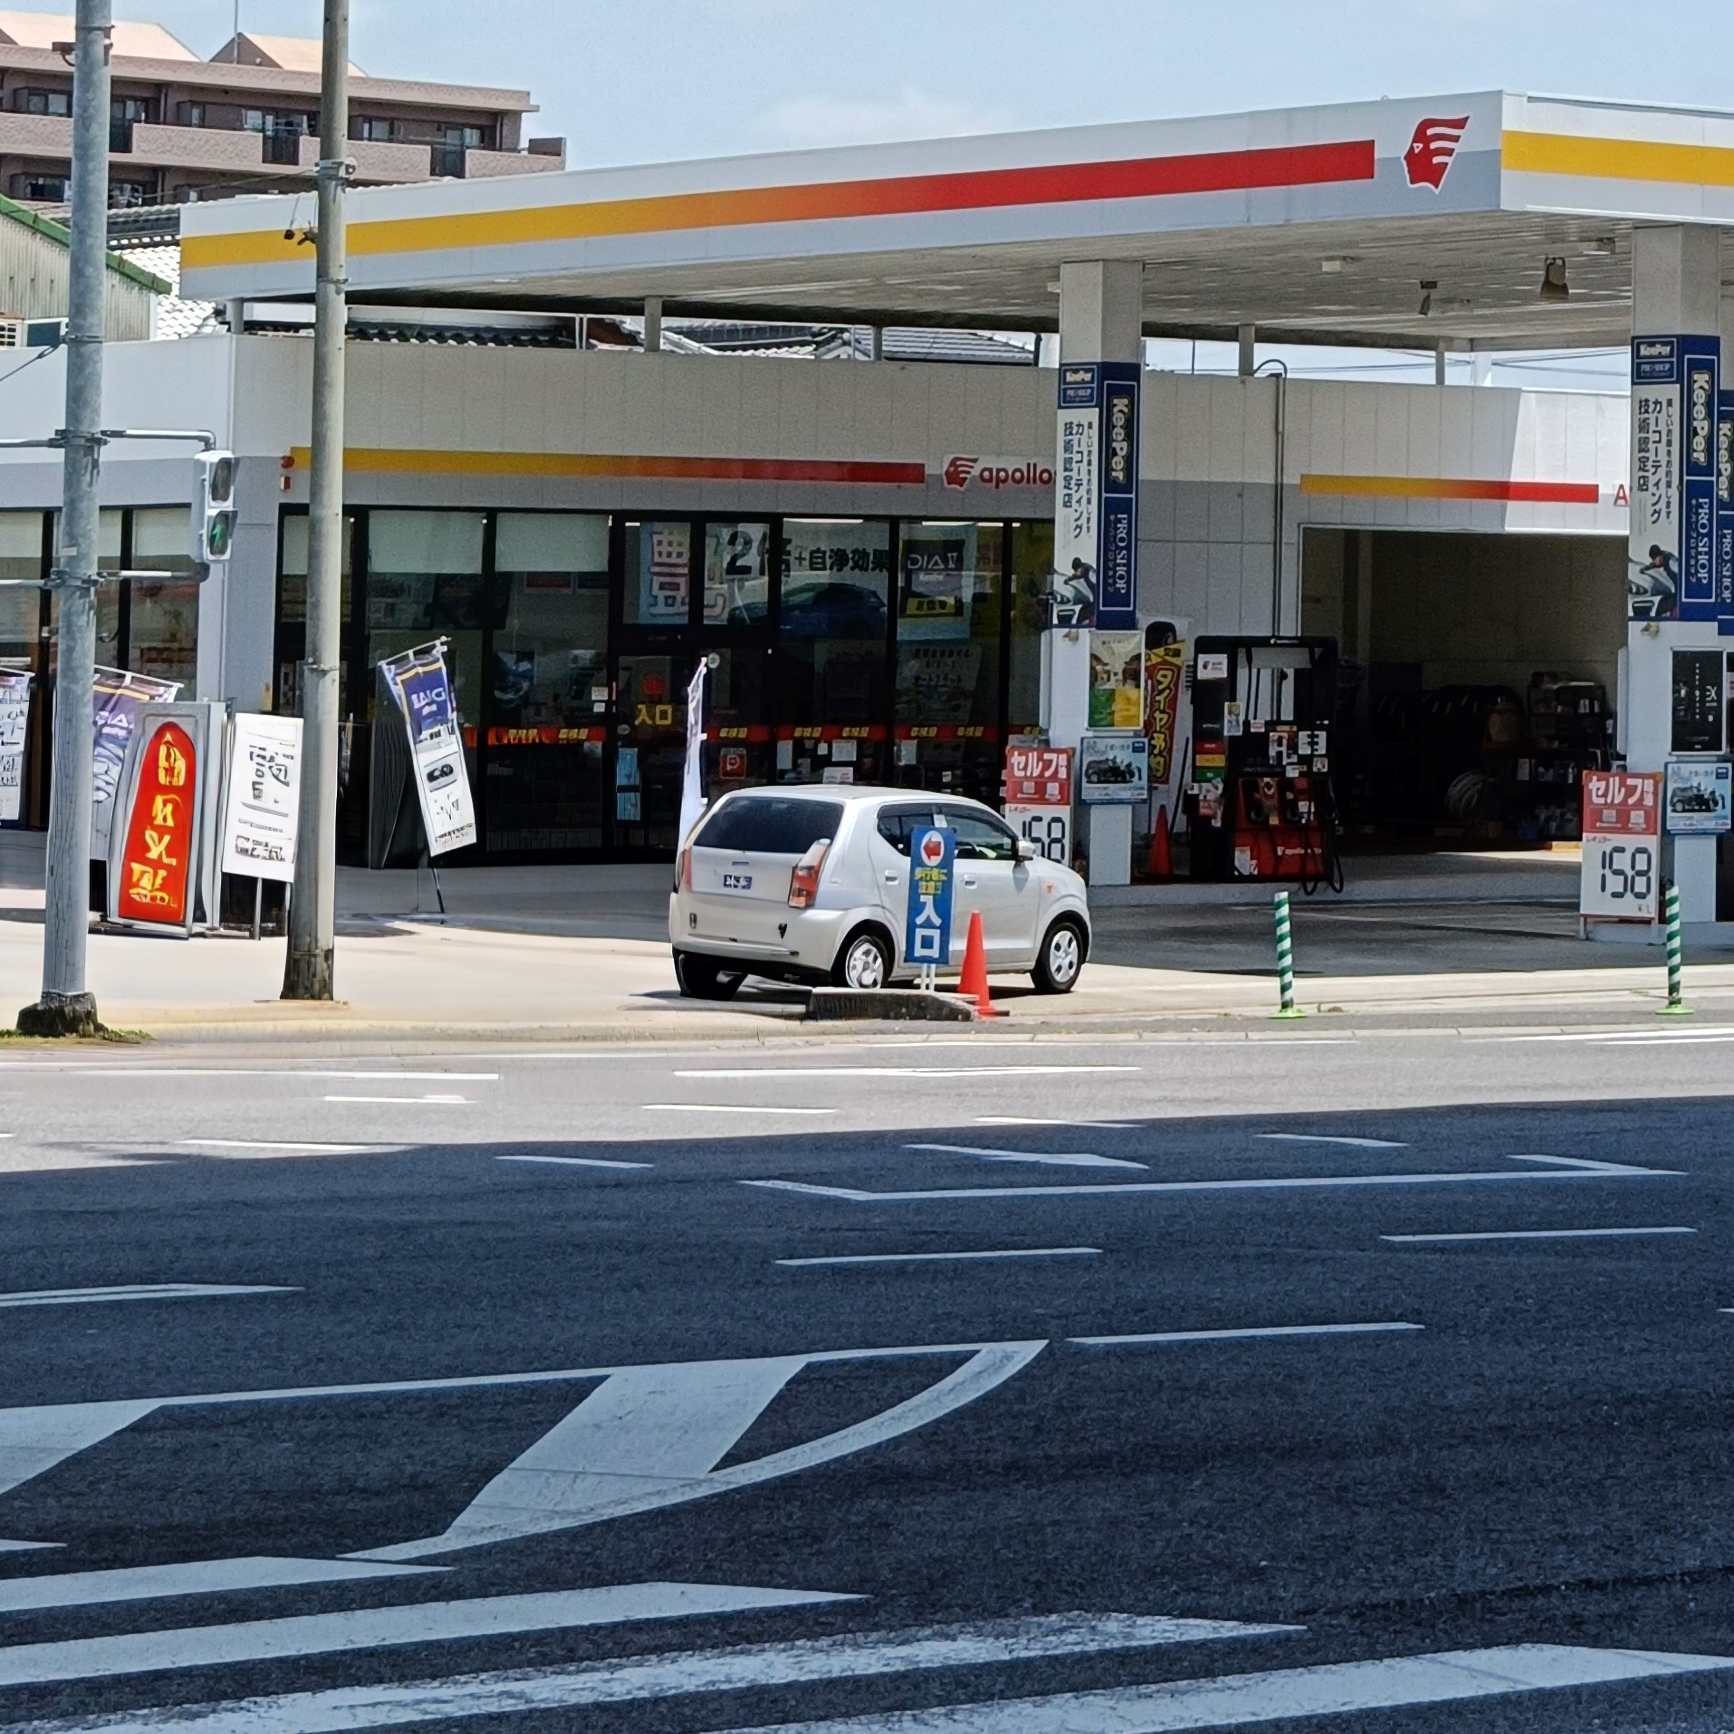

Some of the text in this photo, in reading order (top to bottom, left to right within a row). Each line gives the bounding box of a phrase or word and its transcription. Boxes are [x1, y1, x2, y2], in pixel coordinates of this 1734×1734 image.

[1111, 397, 1129, 482] KeePer
[1637, 397, 1651, 492] 技術認定店
[1691, 372, 1710, 465] KeePer
[978, 462, 1057, 490] apollo
[1073, 420, 1085, 539] カーコーティング
[1651, 398, 1663, 525] カーコーティング
[1718, 421, 1734, 501] KeePer
[1115, 513, 1128, 594] PRO SHOP
[1697, 498, 1710, 584] PRO SHOP
[1721, 529, 1733, 603] PRO SHOP
[634, 704, 673, 726] 入口
[1010, 750, 1058, 778] セルフ
[1588, 775, 1643, 805] セルフ
[1600, 845, 1652, 900] 158
[913, 894, 943, 959] 入口
